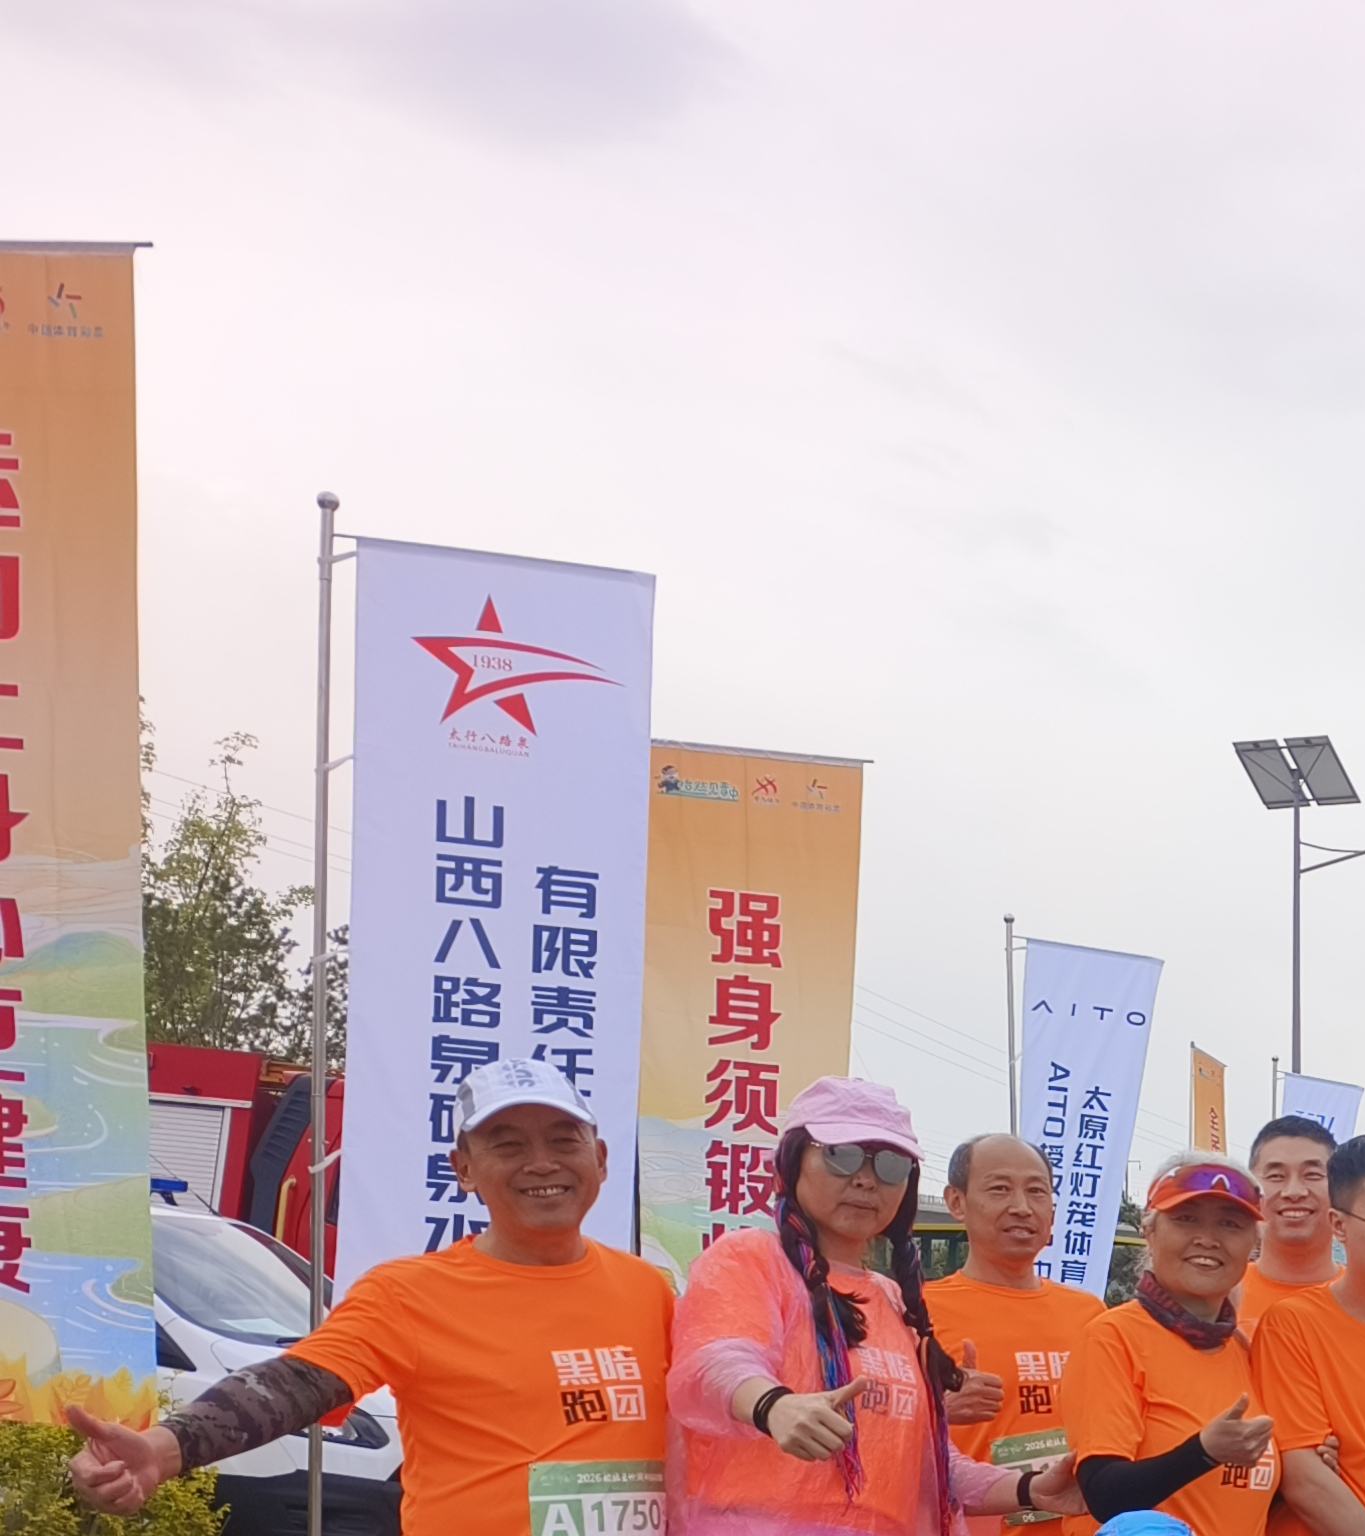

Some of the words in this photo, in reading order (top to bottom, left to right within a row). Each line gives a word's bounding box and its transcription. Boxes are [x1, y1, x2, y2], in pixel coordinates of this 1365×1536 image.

[472, 654, 513, 672] 1938
[1031, 999, 1146, 1027] AITO
[702, 887, 783, 1249] 强身须锻
[1060, 1085, 1112, 1284] 太原红灯笼体育
[550, 1345, 643, 1386] 黑暗
[857, 1348, 917, 1385] 黑暗
[559, 1384, 647, 1426] 跑团
[861, 1379, 918, 1421] 跑团
[1221, 1459, 1276, 1492] 跑团
